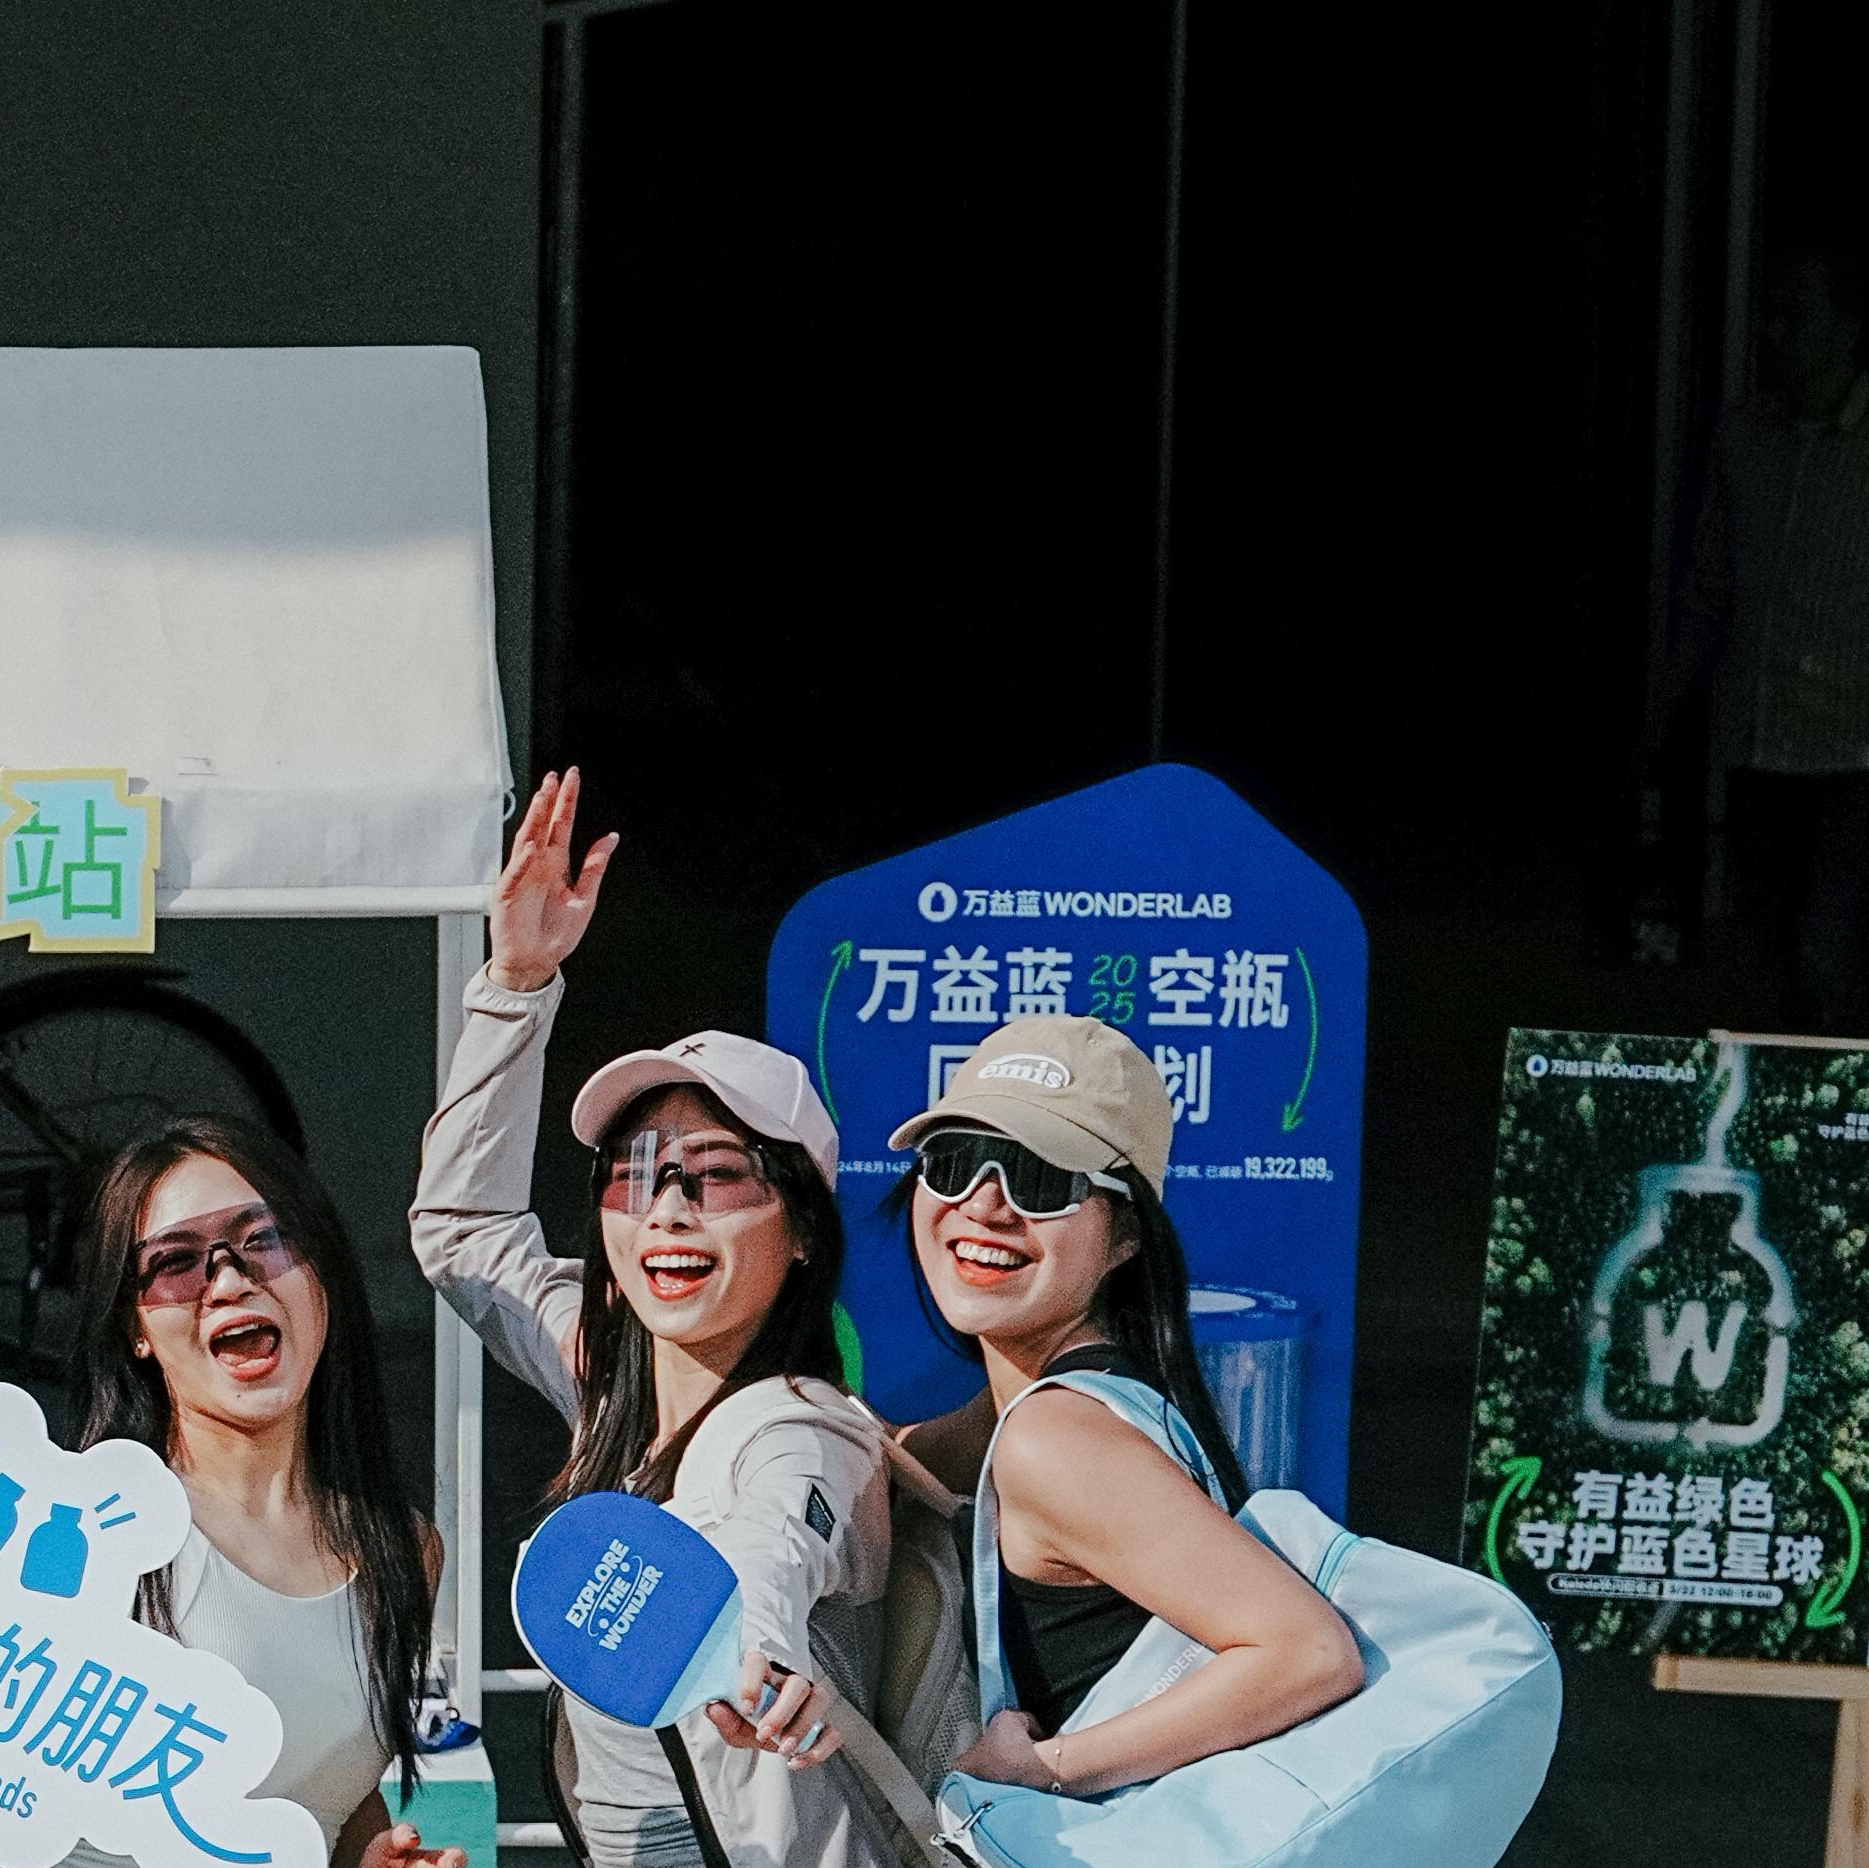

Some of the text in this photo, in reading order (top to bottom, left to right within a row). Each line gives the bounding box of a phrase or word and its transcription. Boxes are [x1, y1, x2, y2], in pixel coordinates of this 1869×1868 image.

[963, 889, 1232, 918] 万益蓝 WONDERLAB
[856, 944, 1073, 1023] 万益蓝
[1148, 947, 1290, 1028] 空瓶
[978, 1061, 1063, 1089] emis
[1593, 1062, 1698, 1082] WONDERLAB
[1572, 1469, 1776, 1529] 有益绿色
[1517, 1520, 1826, 1583] 守护蓝色星球
[565, 1538, 630, 1629] EXPLORE
[598, 1564, 664, 1652] WONDER
[599, 1576, 631, 1614] THE
